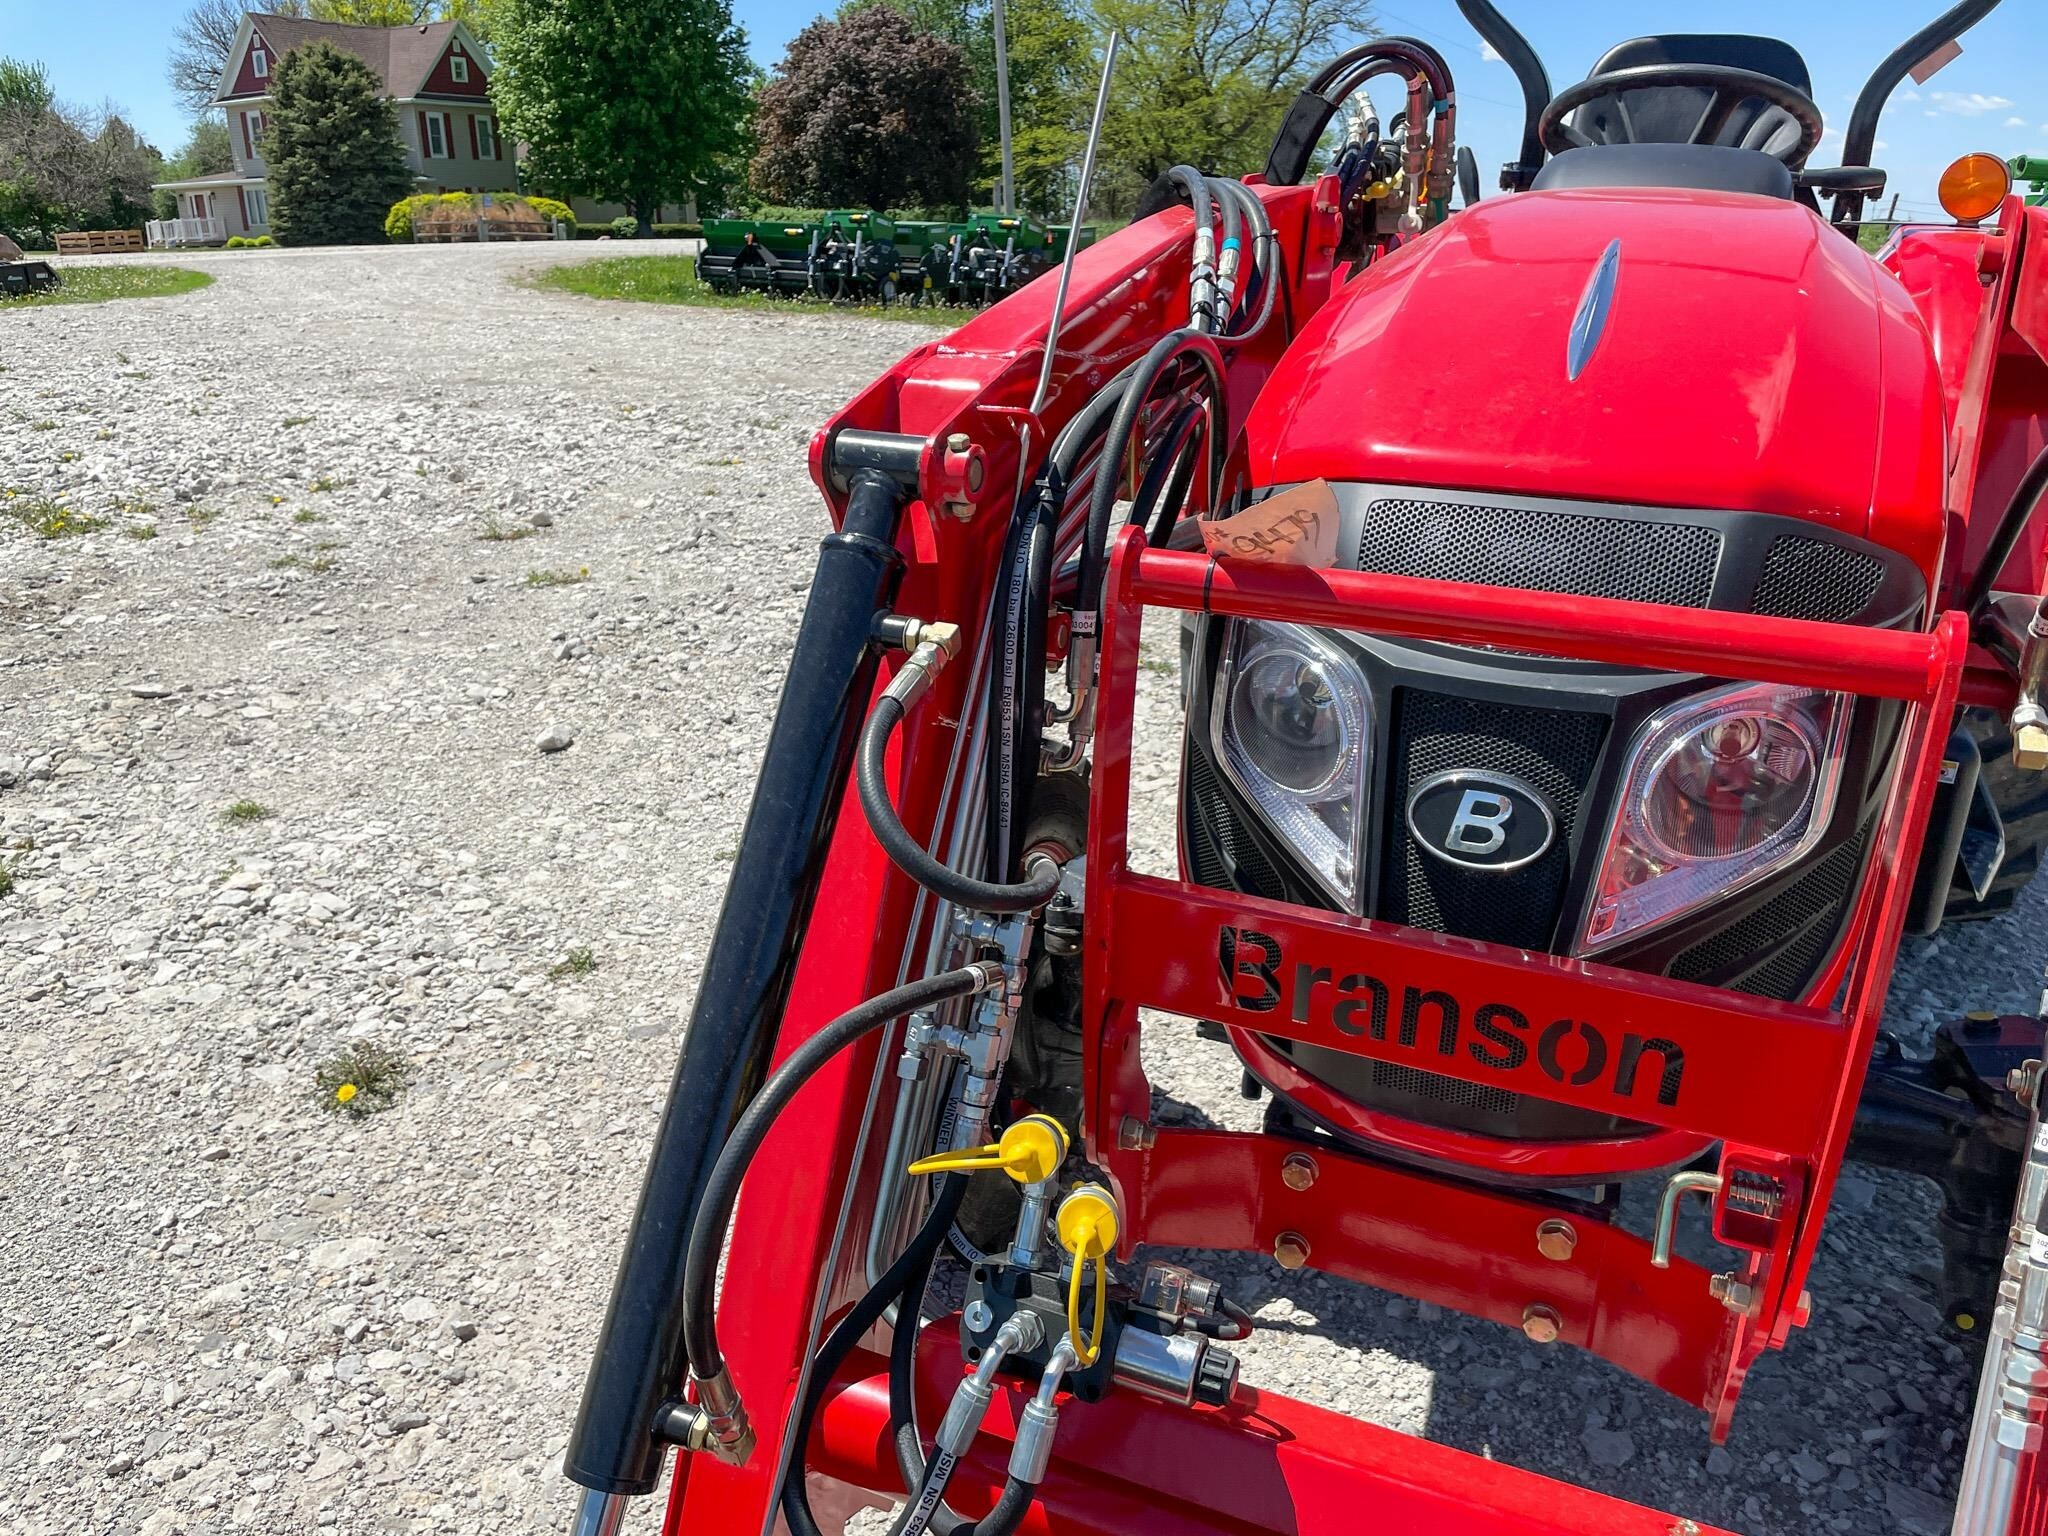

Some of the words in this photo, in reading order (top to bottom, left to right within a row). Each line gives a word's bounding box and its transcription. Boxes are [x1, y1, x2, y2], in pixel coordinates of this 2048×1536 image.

[1015, 533, 1031, 564] DN10
[1010, 573, 1022, 594] 180
[1008, 599, 1019, 616] bar
[1005, 621, 1017, 655] (2600
[1003, 659, 1014, 678] psi)
[1002, 685, 1013, 722] EN853
[1001, 726, 1011, 747] 1SN
[1001, 753, 1011, 785] MSHA
[1444, 789, 1513, 855] B
[1217, 924, 1686, 1107] Branson
[937, 1096, 961, 1146] WINNER
[950, 1232, 966, 1251] mm
[919, 1486, 940, 1512] 1SN
